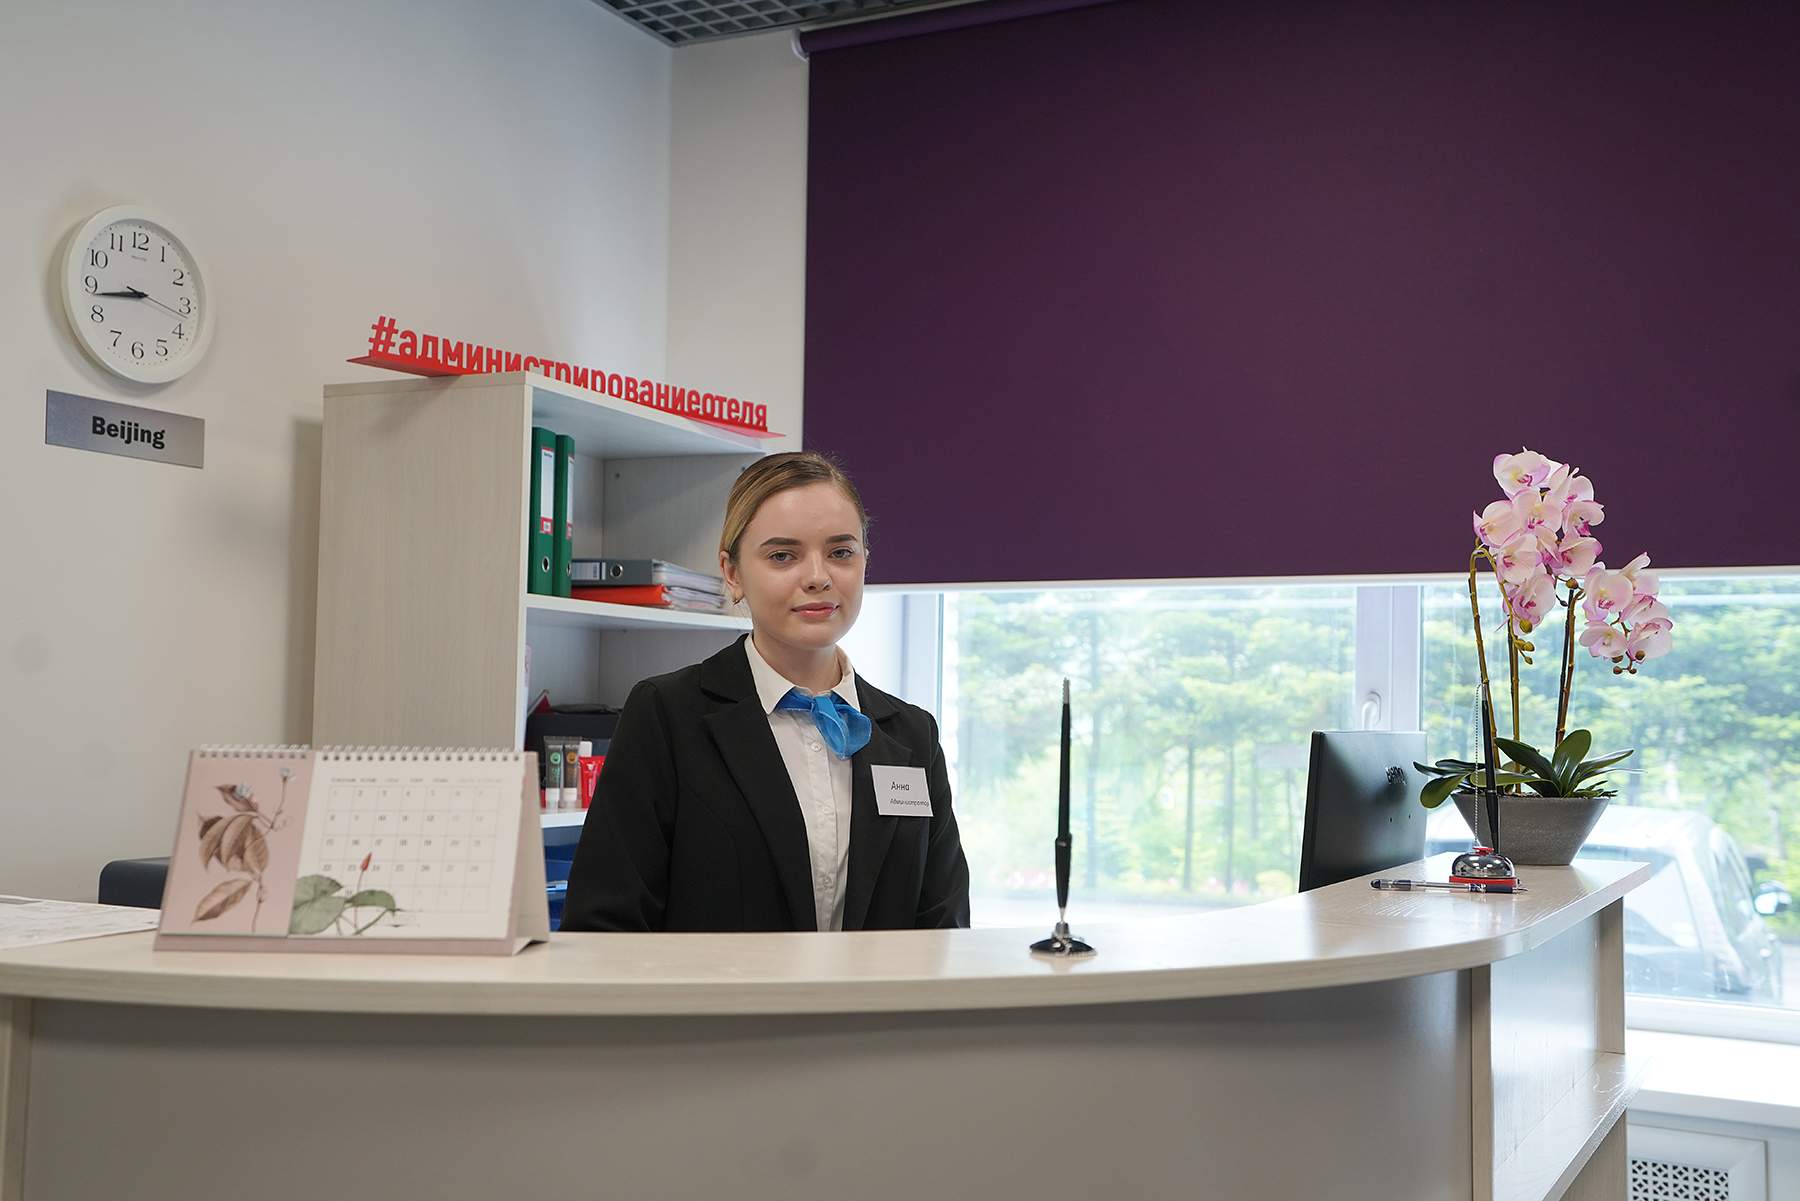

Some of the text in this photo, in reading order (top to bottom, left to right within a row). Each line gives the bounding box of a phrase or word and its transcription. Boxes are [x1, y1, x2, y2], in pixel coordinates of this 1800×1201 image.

[110, 232, 123, 252] 11
[131, 231, 150, 251] 12
[90, 248, 108, 269] 10
[160, 245, 166, 263] 1
[84, 275, 98, 294] 9
[172, 268, 185, 287] 2
[90, 304, 104, 323] 8
[179, 296, 191, 315] 3
[109, 329, 122, 347] 7
[172, 323, 185, 339] 4
[131, 341, 145, 359] 6
[155, 339, 168, 357] 5
[92, 415, 165, 450] Beijing
